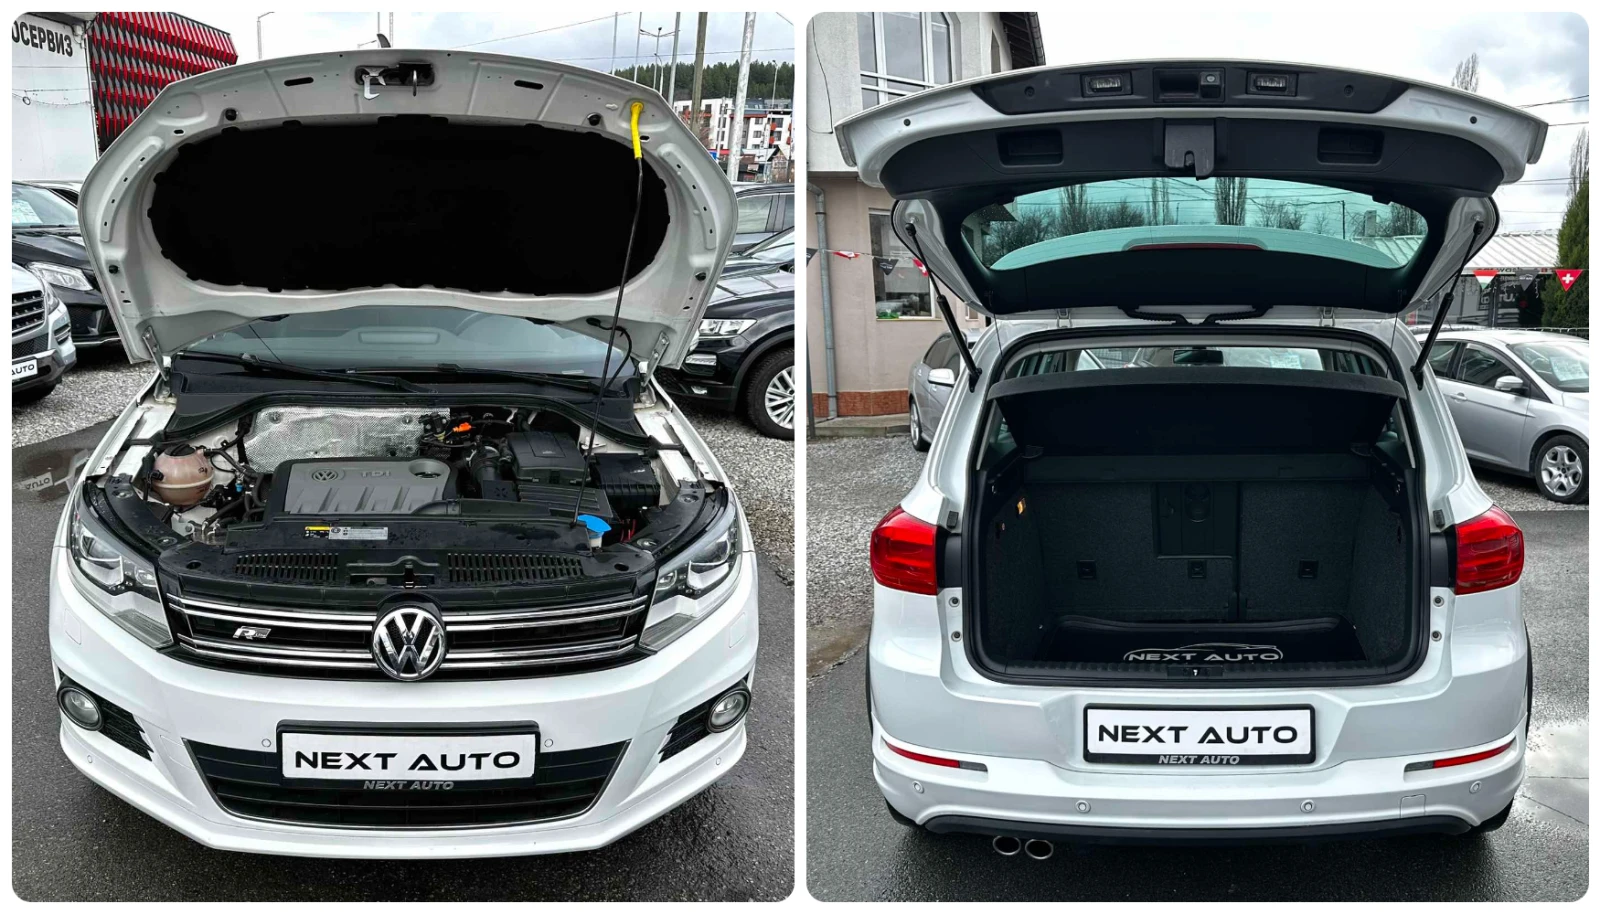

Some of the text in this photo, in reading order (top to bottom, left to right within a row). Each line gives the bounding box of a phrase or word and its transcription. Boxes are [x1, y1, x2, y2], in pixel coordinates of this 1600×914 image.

[375, 608, 443, 679] VW
[1128, 653, 1279, 661] NEXT AUTO
[1098, 724, 1298, 744] NEXT AUTO
[295, 751, 520, 771] NEXT AUTO
[1158, 755, 1240, 765] NEXT AUTO
[363, 780, 454, 790] NEXT AUTO
